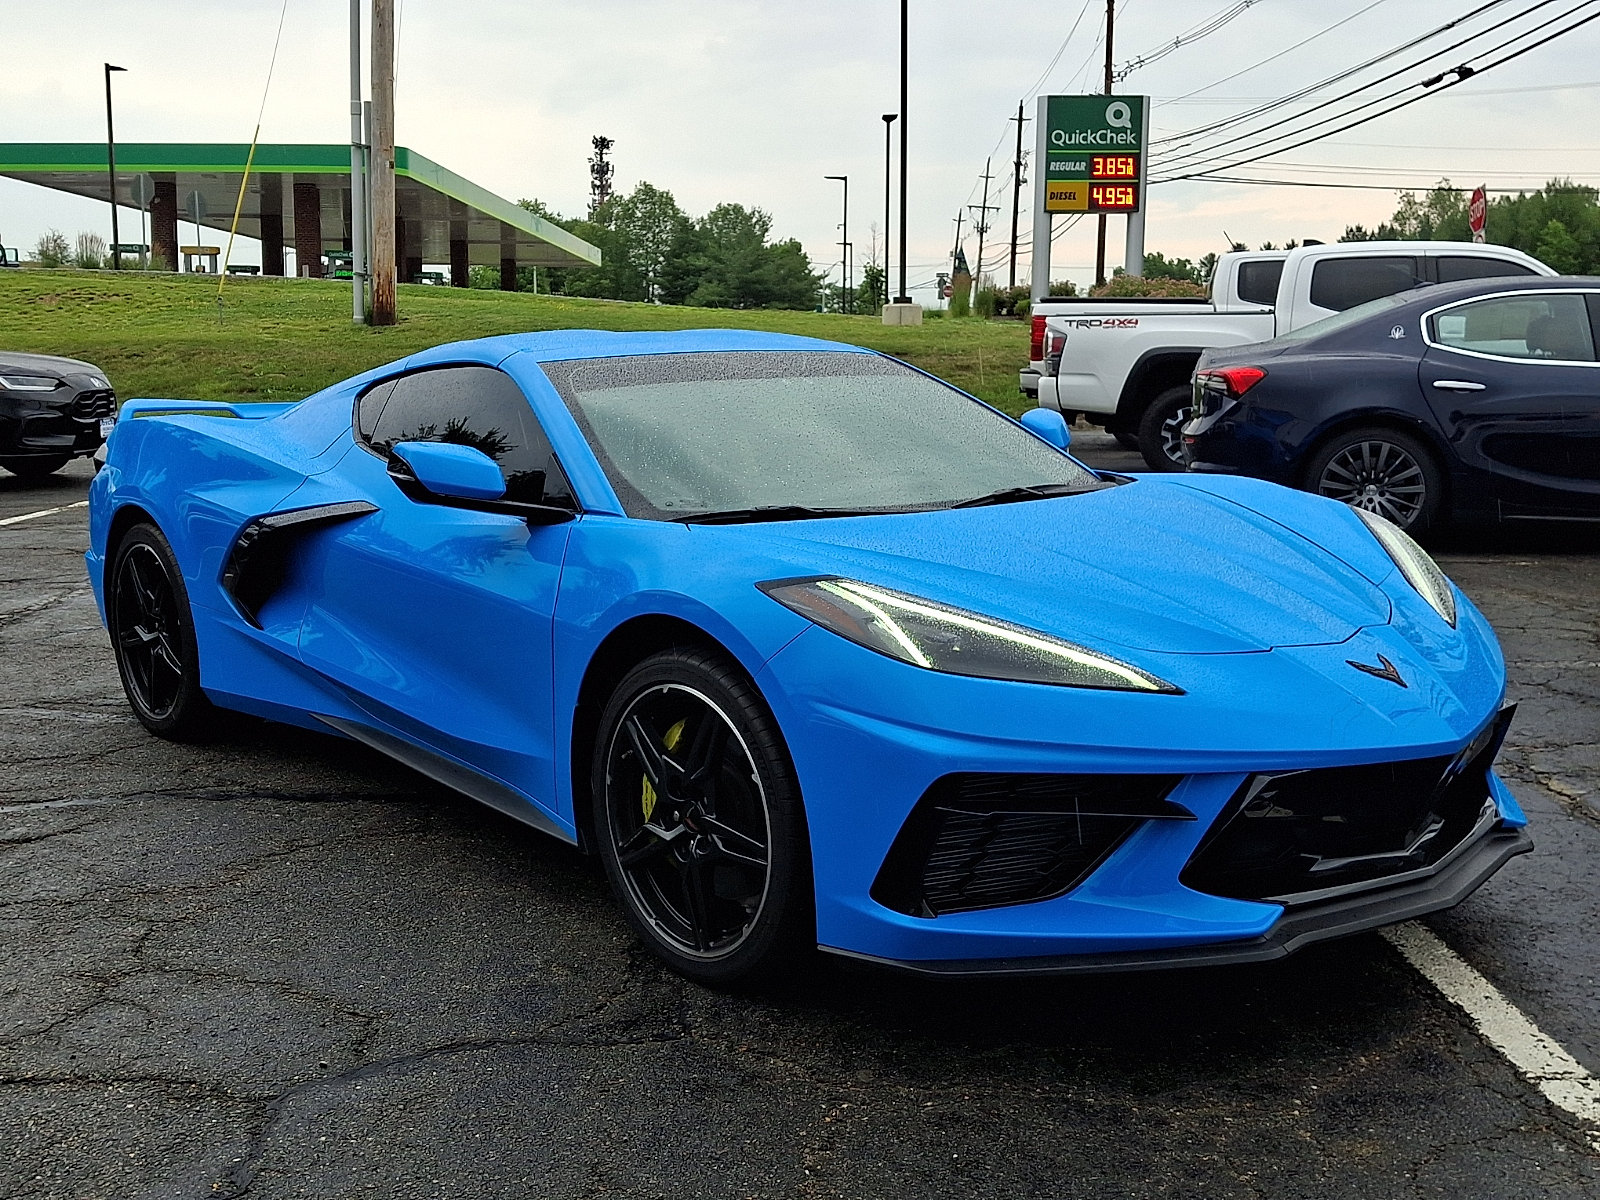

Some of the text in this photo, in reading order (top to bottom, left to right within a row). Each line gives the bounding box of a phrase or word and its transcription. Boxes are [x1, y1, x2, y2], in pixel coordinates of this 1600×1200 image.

[1051, 129, 1136, 146] QuickChek
[1049, 162, 1086, 171] REGULAR
[1049, 191, 1077, 200] DIESEL
